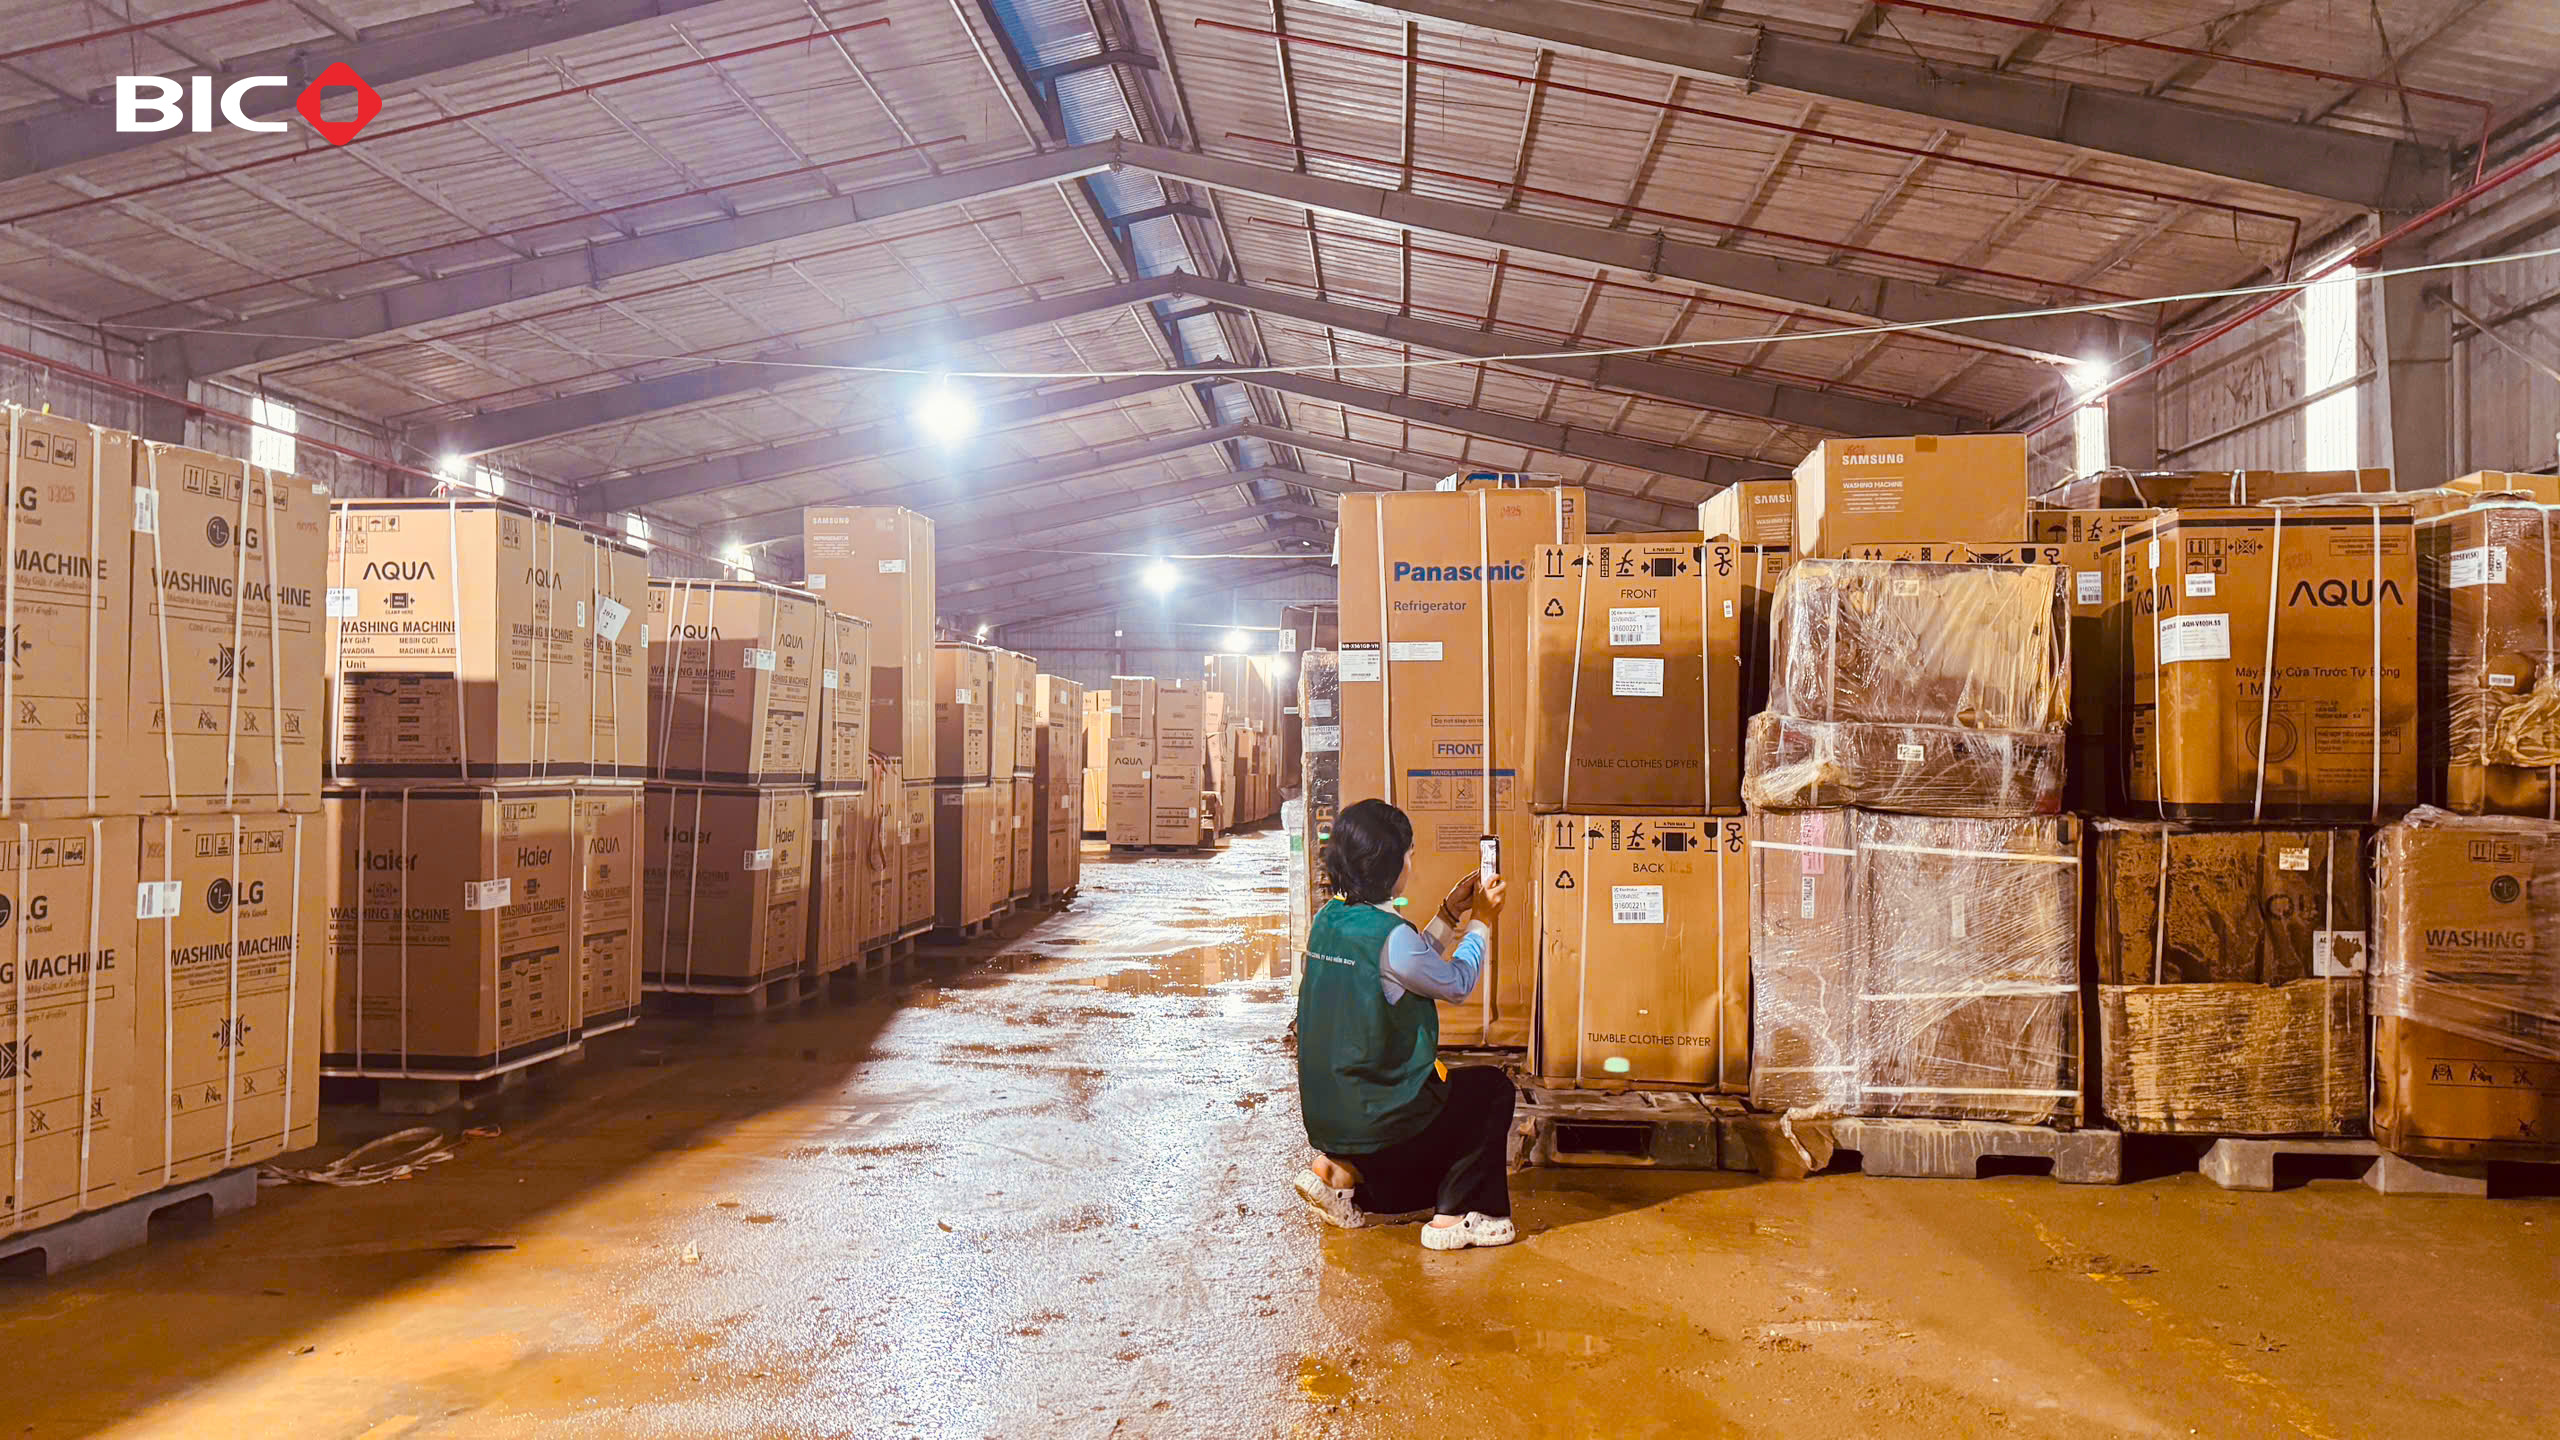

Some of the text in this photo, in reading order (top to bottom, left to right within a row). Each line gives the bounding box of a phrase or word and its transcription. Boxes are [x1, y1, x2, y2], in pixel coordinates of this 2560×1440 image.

[1841, 454, 1905, 466] SAMSUNG
[1842, 480, 1904, 489] WASHING MACHINE
[812, 516, 850, 525] SAMSUNG
[14, 548, 108, 580] MACHINE
[363, 560, 436, 581] AQUA
[1394, 560, 1525, 582] Panasonic
[526, 567, 562, 591] AQUA
[151, 567, 233, 598] WASHING
[243, 581, 312, 608] MACHINE
[1620, 588, 1657, 599] FRONT
[2289, 579, 2404, 607] AQUA
[1394, 600, 1467, 613] Refrigerator
[2134, 584, 2173, 616] AQUA
[341, 620, 399, 633] WASHING
[512, 622, 543, 637] WASHING
[670, 624, 721, 641] AQUA
[778, 633, 803, 649] AQUA
[342, 647, 375, 655] AVADORA
[346, 660, 366, 669] Unit
[695, 668, 736, 679] MACHINE
[1437, 743, 1484, 755] FRONT
[1114, 757, 1143, 766] AQUA
[1576, 758, 1699, 769] TUMBLE CLOTHES DRYER
[664, 826, 712, 844] Haier
[775, 827, 796, 844] Haier
[588, 838, 621, 855] AQUA
[354, 849, 418, 872] Haier
[517, 846, 552, 868] Haier
[1632, 862, 1665, 874] BACK
[239, 880, 264, 906] LG
[533, 897, 566, 912] MACHINE
[330, 907, 450, 921] WASHING MACHINE
[2425, 929, 2527, 949] WASHING
[171, 933, 300, 967] WASHING MACHIN
[25, 948, 116, 981] MACHINE
[1587, 1032, 1711, 1047] TUMBLE CLOTHES DRYER
